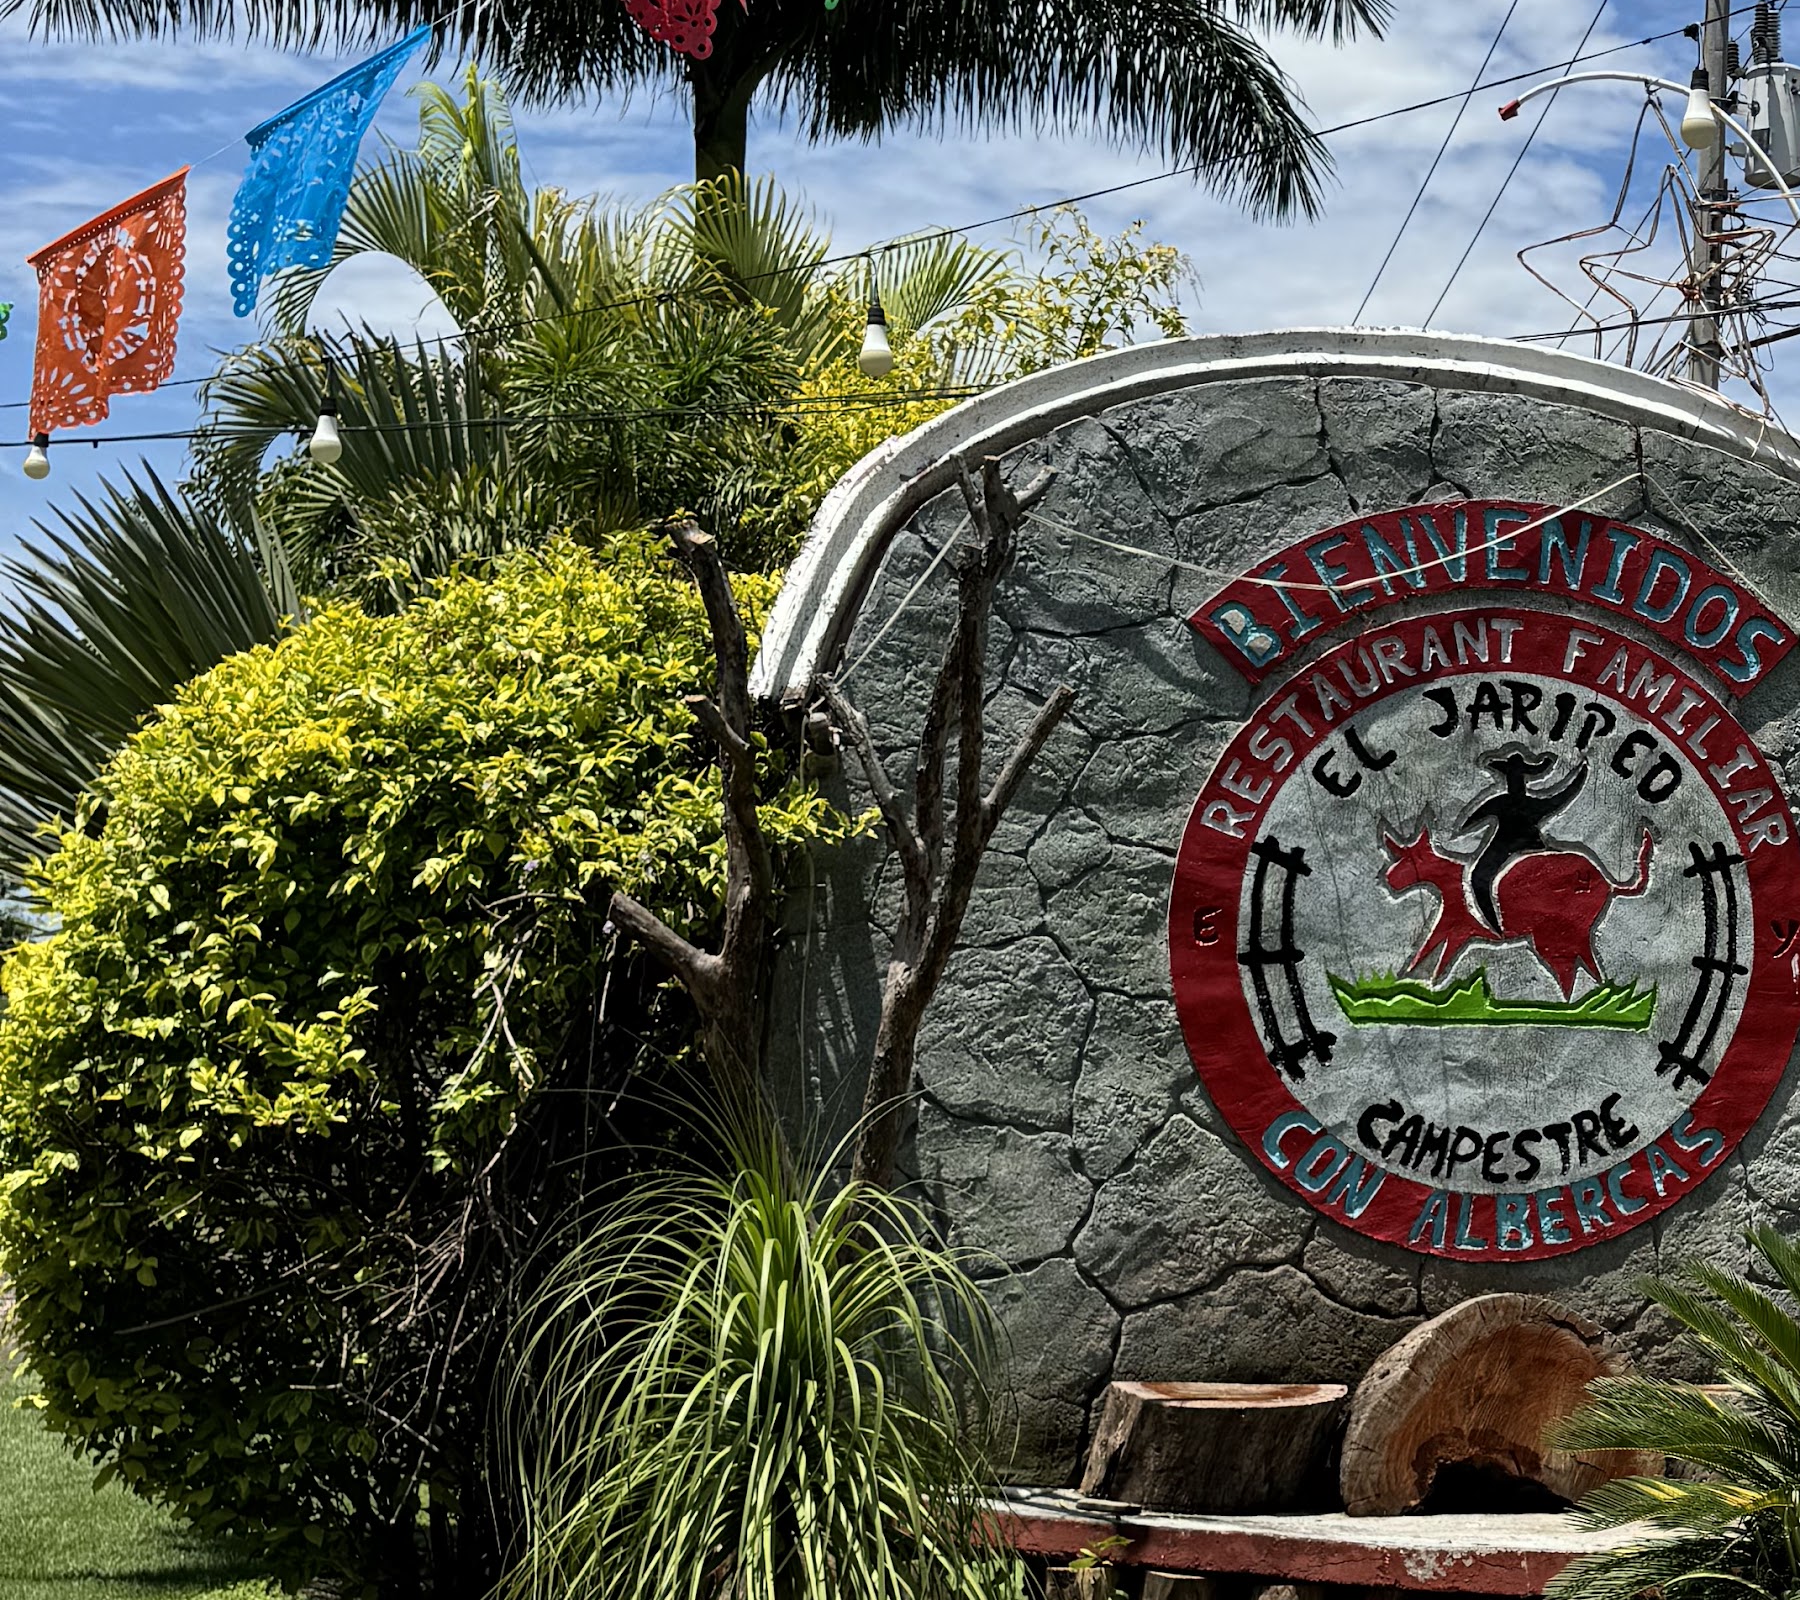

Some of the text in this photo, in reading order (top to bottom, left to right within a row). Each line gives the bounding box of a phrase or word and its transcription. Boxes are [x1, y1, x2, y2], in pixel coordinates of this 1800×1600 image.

[1208, 507, 1786, 682] BIENVENIDOS
[1200, 617, 1790, 853] RESTAURANT FAMILIAR
[1311, 679, 1683, 804] EL JARIPEO
[1261, 1109, 1726, 1252] CON ALBERCAS
[1356, 1091, 1640, 1184] CAMPESTRE
